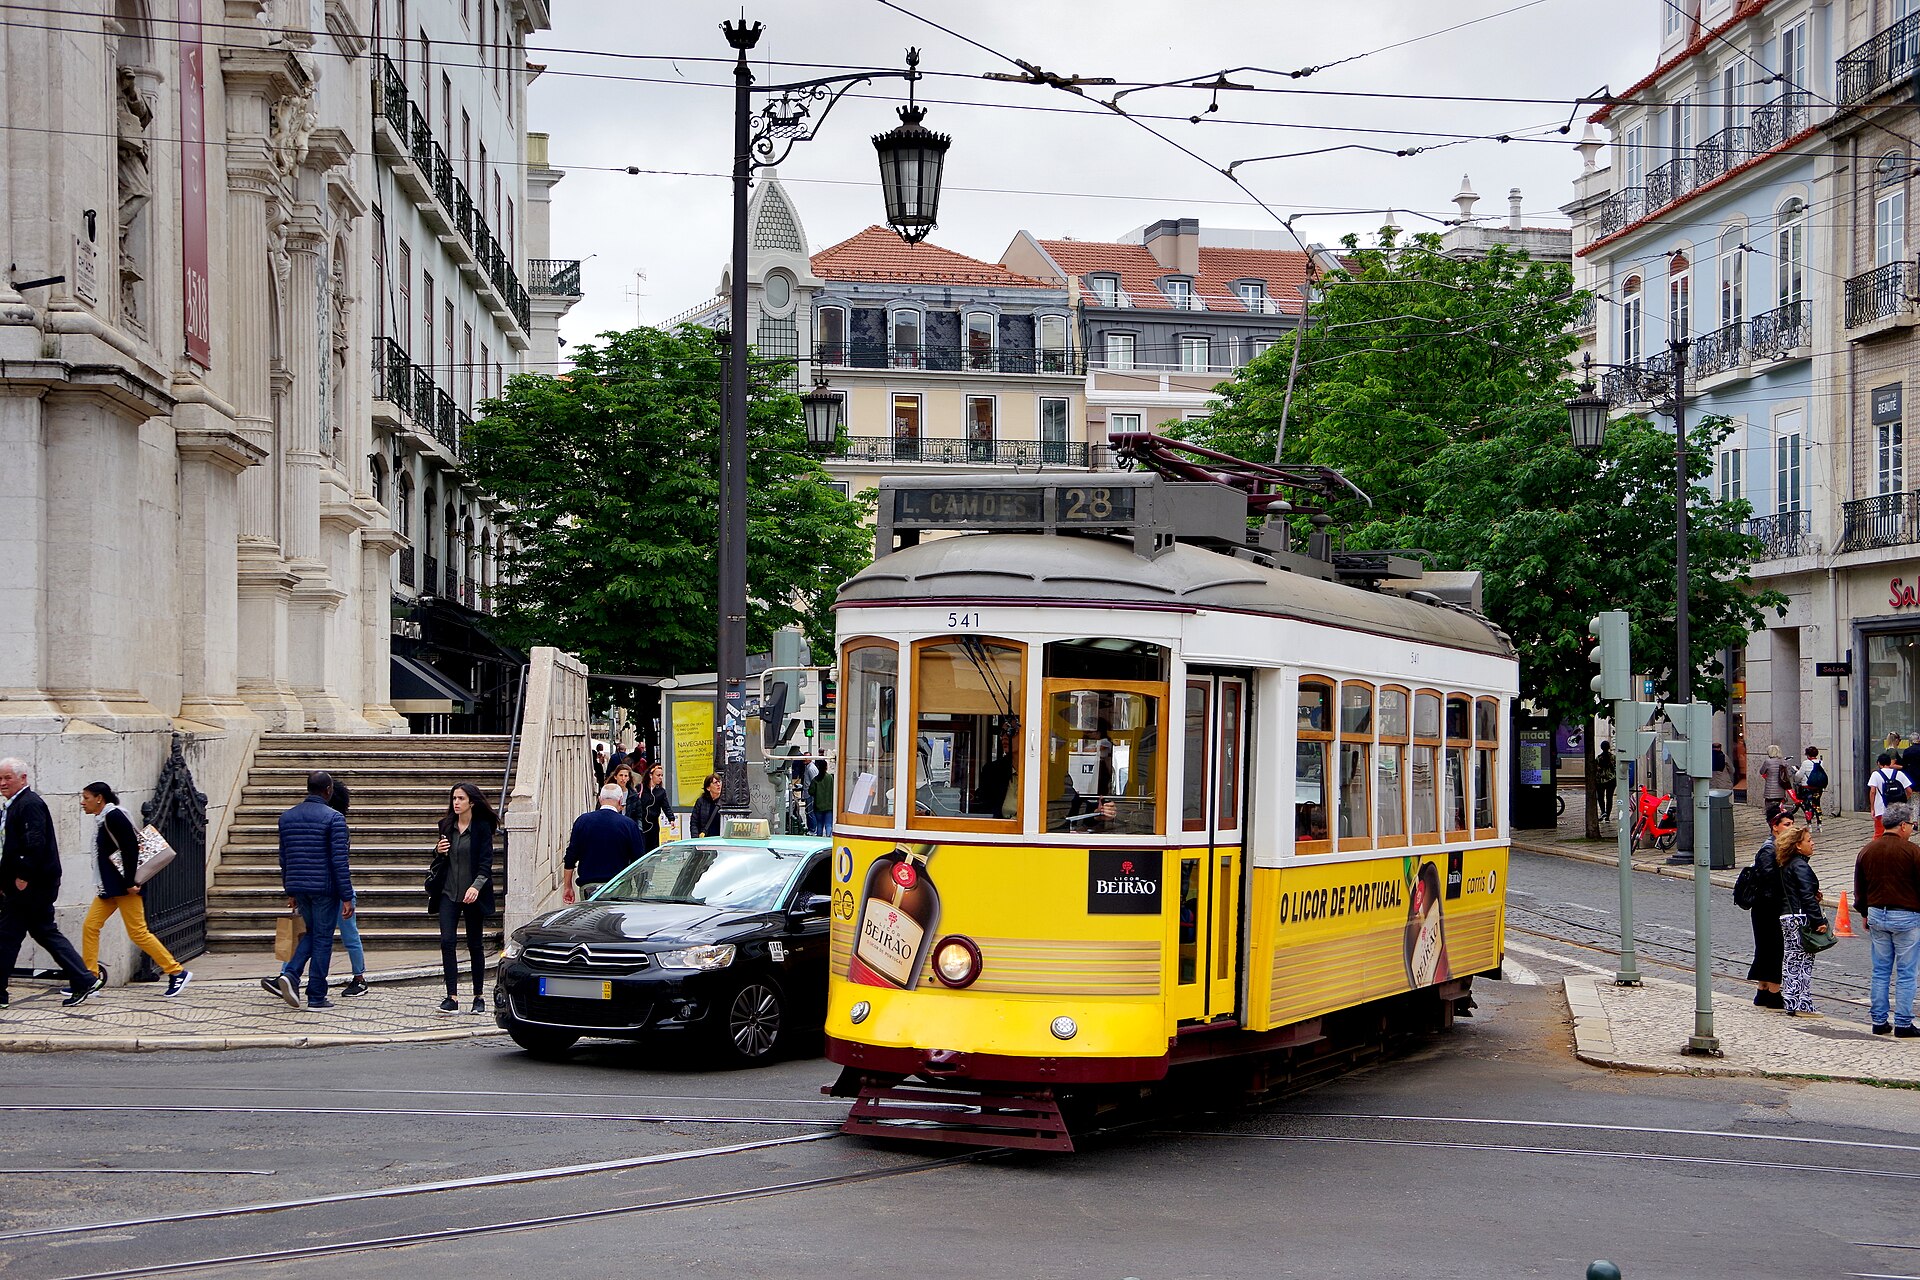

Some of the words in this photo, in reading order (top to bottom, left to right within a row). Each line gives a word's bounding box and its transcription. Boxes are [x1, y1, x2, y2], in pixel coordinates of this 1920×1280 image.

[187, 267, 206, 312] 1518
[187, 298, 207, 343] 2018
[903, 492, 920, 513] L.
[1065, 487, 1113, 519] 28
[948, 612, 979, 628] 541
[677, 739, 714, 748] NAVEGANTE
[1520, 731, 1550, 740] maat
[733, 822, 752, 832] TAXI
[1096, 879, 1156, 895] BEIRÃO
[1466, 870, 1486, 894] carris
[1280, 892, 1289, 924] O
[1291, 888, 1328, 922] LICOR
[1330, 886, 1347, 917] DE
[1348, 879, 1402, 915] PORTUGAL
[865, 919, 912, 960] BEIRÃO
